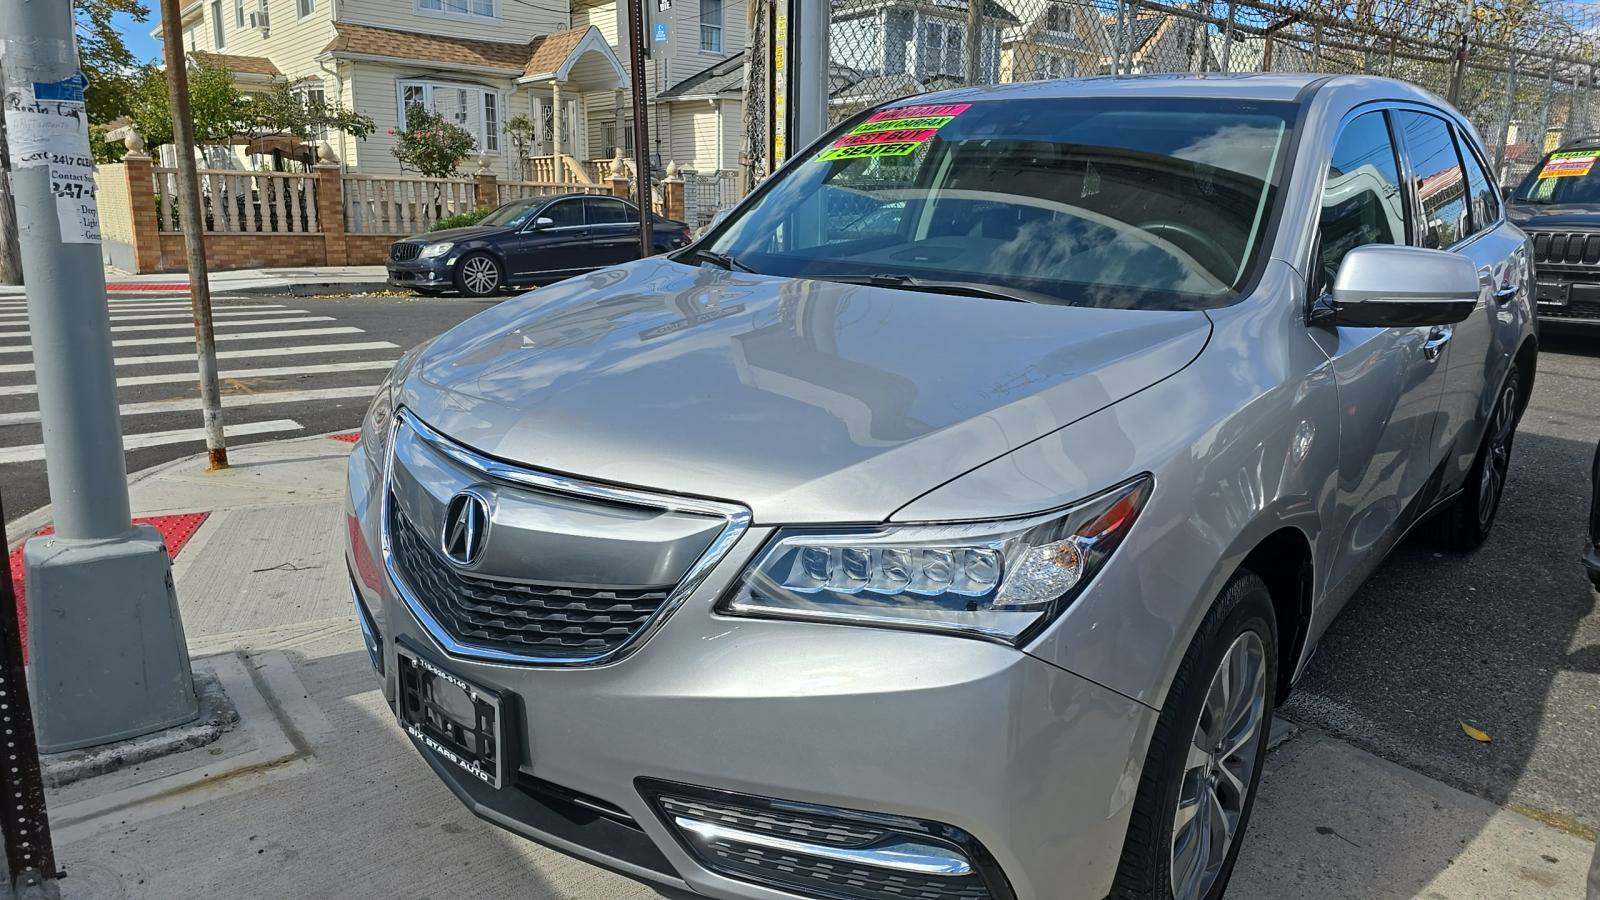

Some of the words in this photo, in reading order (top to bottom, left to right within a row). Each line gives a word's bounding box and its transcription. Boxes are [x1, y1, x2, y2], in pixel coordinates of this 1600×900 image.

[885, 129, 924, 142] BUY
[837, 143, 915, 158] SEATER
[52, 170, 83, 181] Contact
[408, 726, 424, 742] SIX
[426, 740, 458, 763] STARS
[459, 760, 488, 782] AUTO
